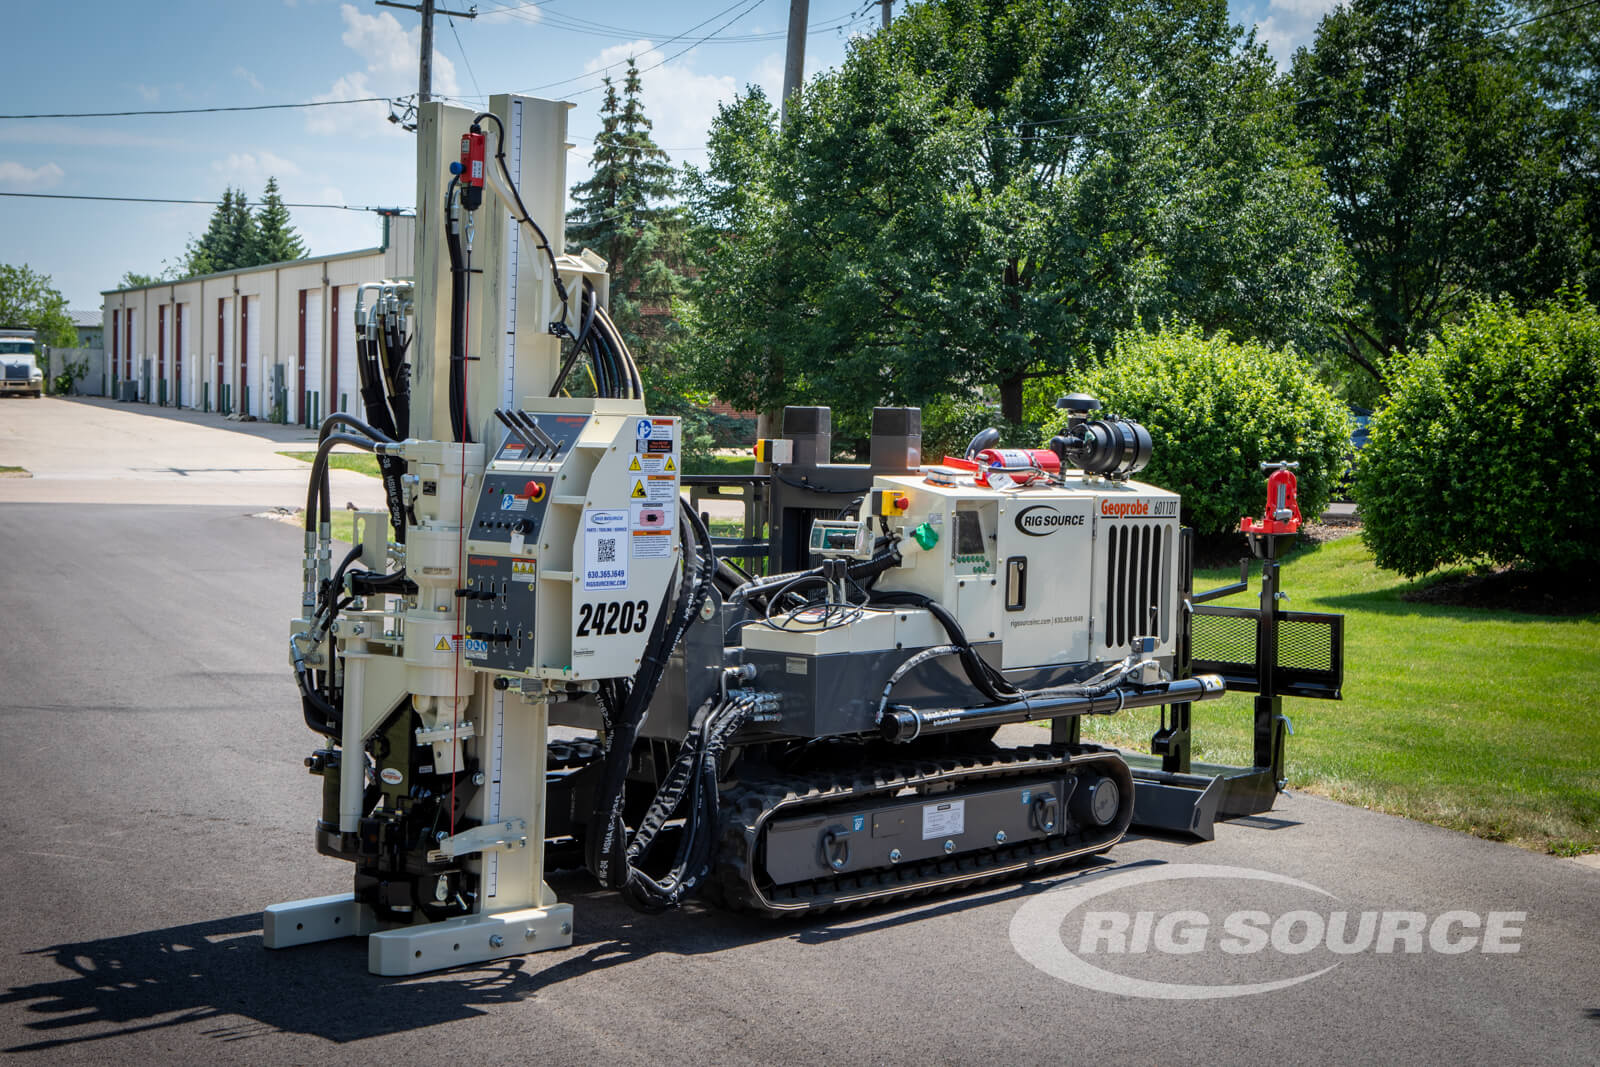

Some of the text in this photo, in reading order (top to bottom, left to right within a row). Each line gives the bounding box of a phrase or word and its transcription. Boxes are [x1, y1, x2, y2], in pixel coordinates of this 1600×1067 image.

[1101, 499, 1177, 519] Geoprobe 6011DT
[1024, 515, 1085, 526] RIG SOURCE
[587, 570, 625, 579] 630.365.1649
[576, 600, 648, 637] 24203
